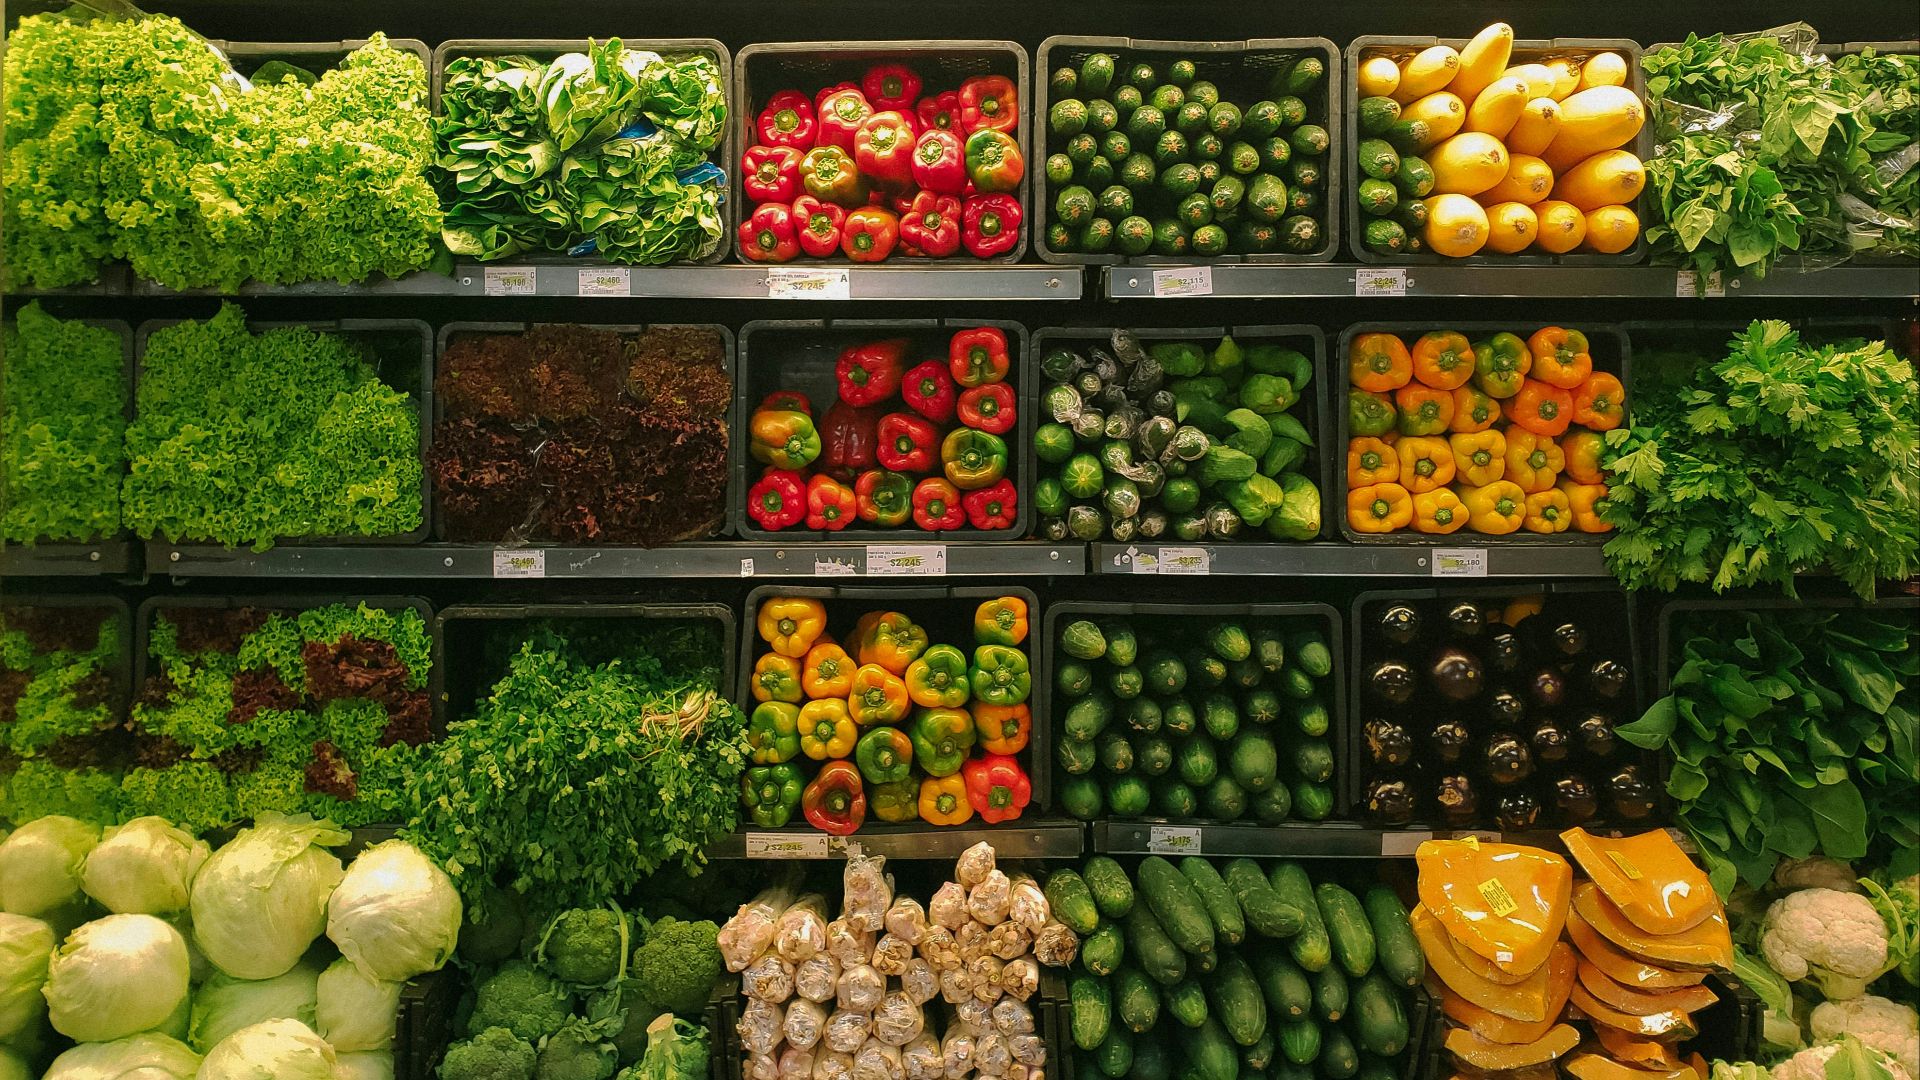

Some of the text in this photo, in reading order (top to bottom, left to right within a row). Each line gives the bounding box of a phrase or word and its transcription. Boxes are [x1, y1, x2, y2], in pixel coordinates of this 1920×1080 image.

[624, 269, 629, 277] C
[596, 276, 621, 285] $2,460
[840, 274, 848, 283] A
[1178, 277, 1204, 286] $2,115
[1374, 277, 1398, 286] $2,245
[792, 282, 825, 291] $2,245
[538, 550, 544, 558] C
[936, 550, 944, 559] A
[511, 557, 535, 566] $2,460
[890, 558, 921, 567] $2,245
[771, 843, 803, 852] $2,245
